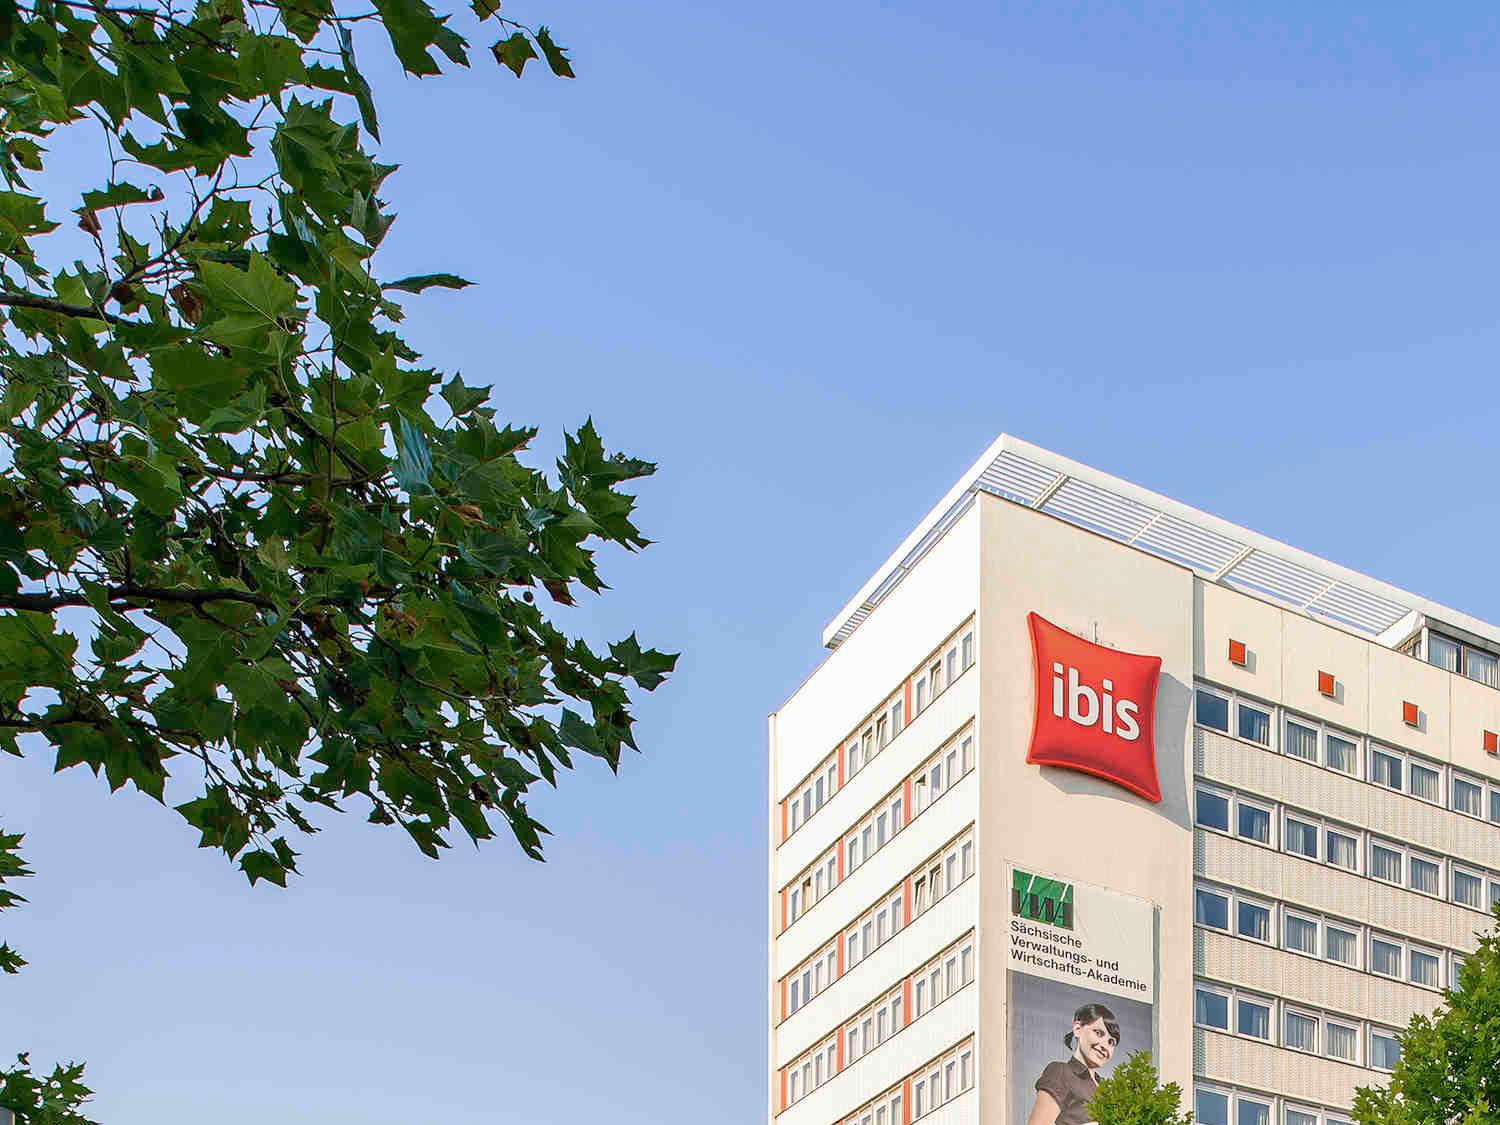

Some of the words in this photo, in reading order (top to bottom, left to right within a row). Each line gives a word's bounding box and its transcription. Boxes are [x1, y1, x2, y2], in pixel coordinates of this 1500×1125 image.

[1052, 661, 1140, 740] ibis
[1010, 920, 1082, 949] Sächsische
[1010, 934, 1092, 964] Verwaltungs-
[1096, 960, 1119, 972] und
[1010, 949, 1147, 992] Wirtschafts-Akademie
